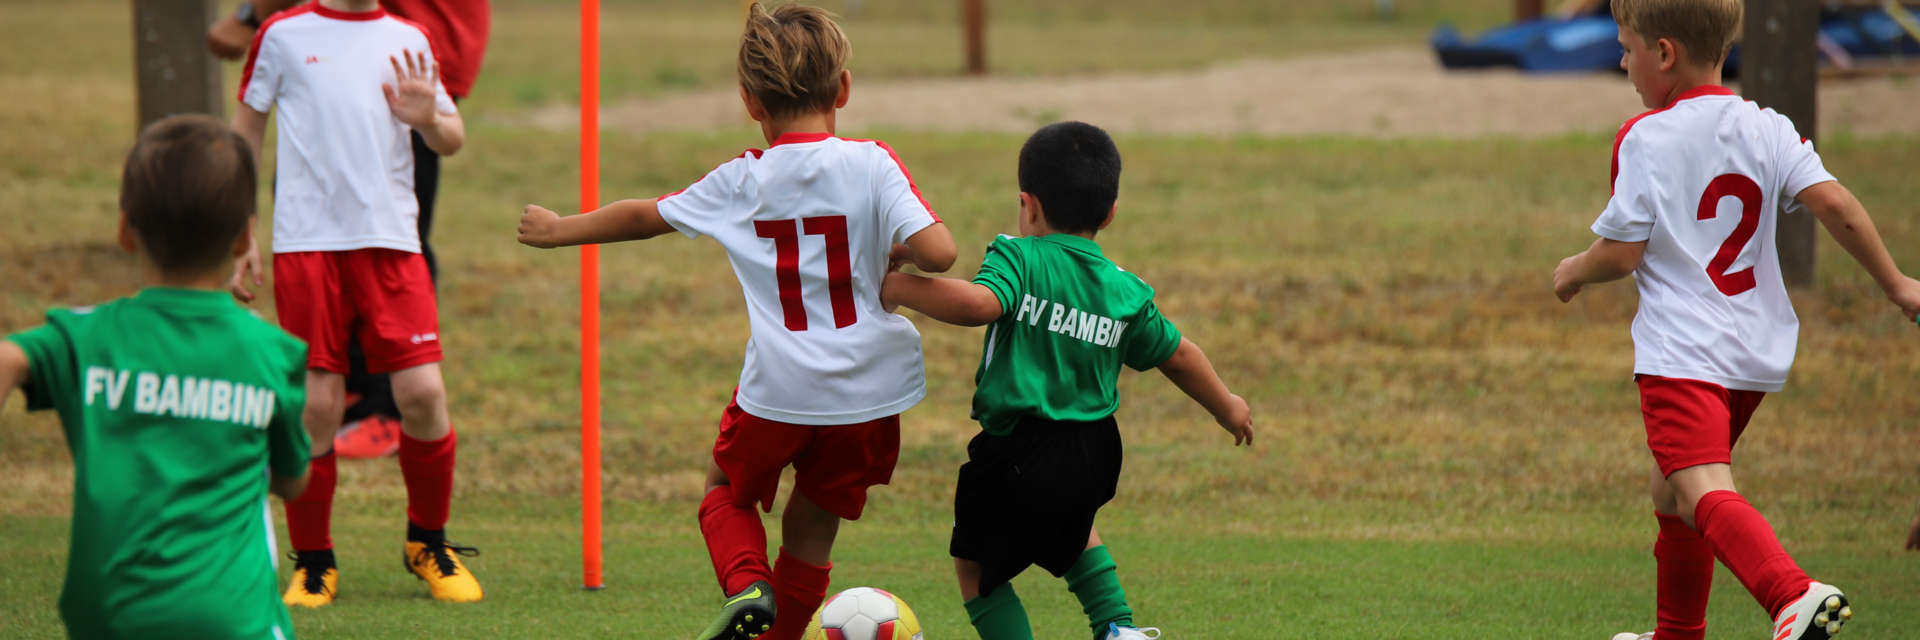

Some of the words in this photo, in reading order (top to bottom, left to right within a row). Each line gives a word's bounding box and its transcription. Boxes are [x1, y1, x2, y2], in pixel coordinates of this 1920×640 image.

[753, 215, 857, 331] 11
[1697, 173, 1762, 297] 2
[1016, 293, 1048, 327] FV
[85, 366, 130, 410] FV
[134, 372, 275, 430] BAMBINI
